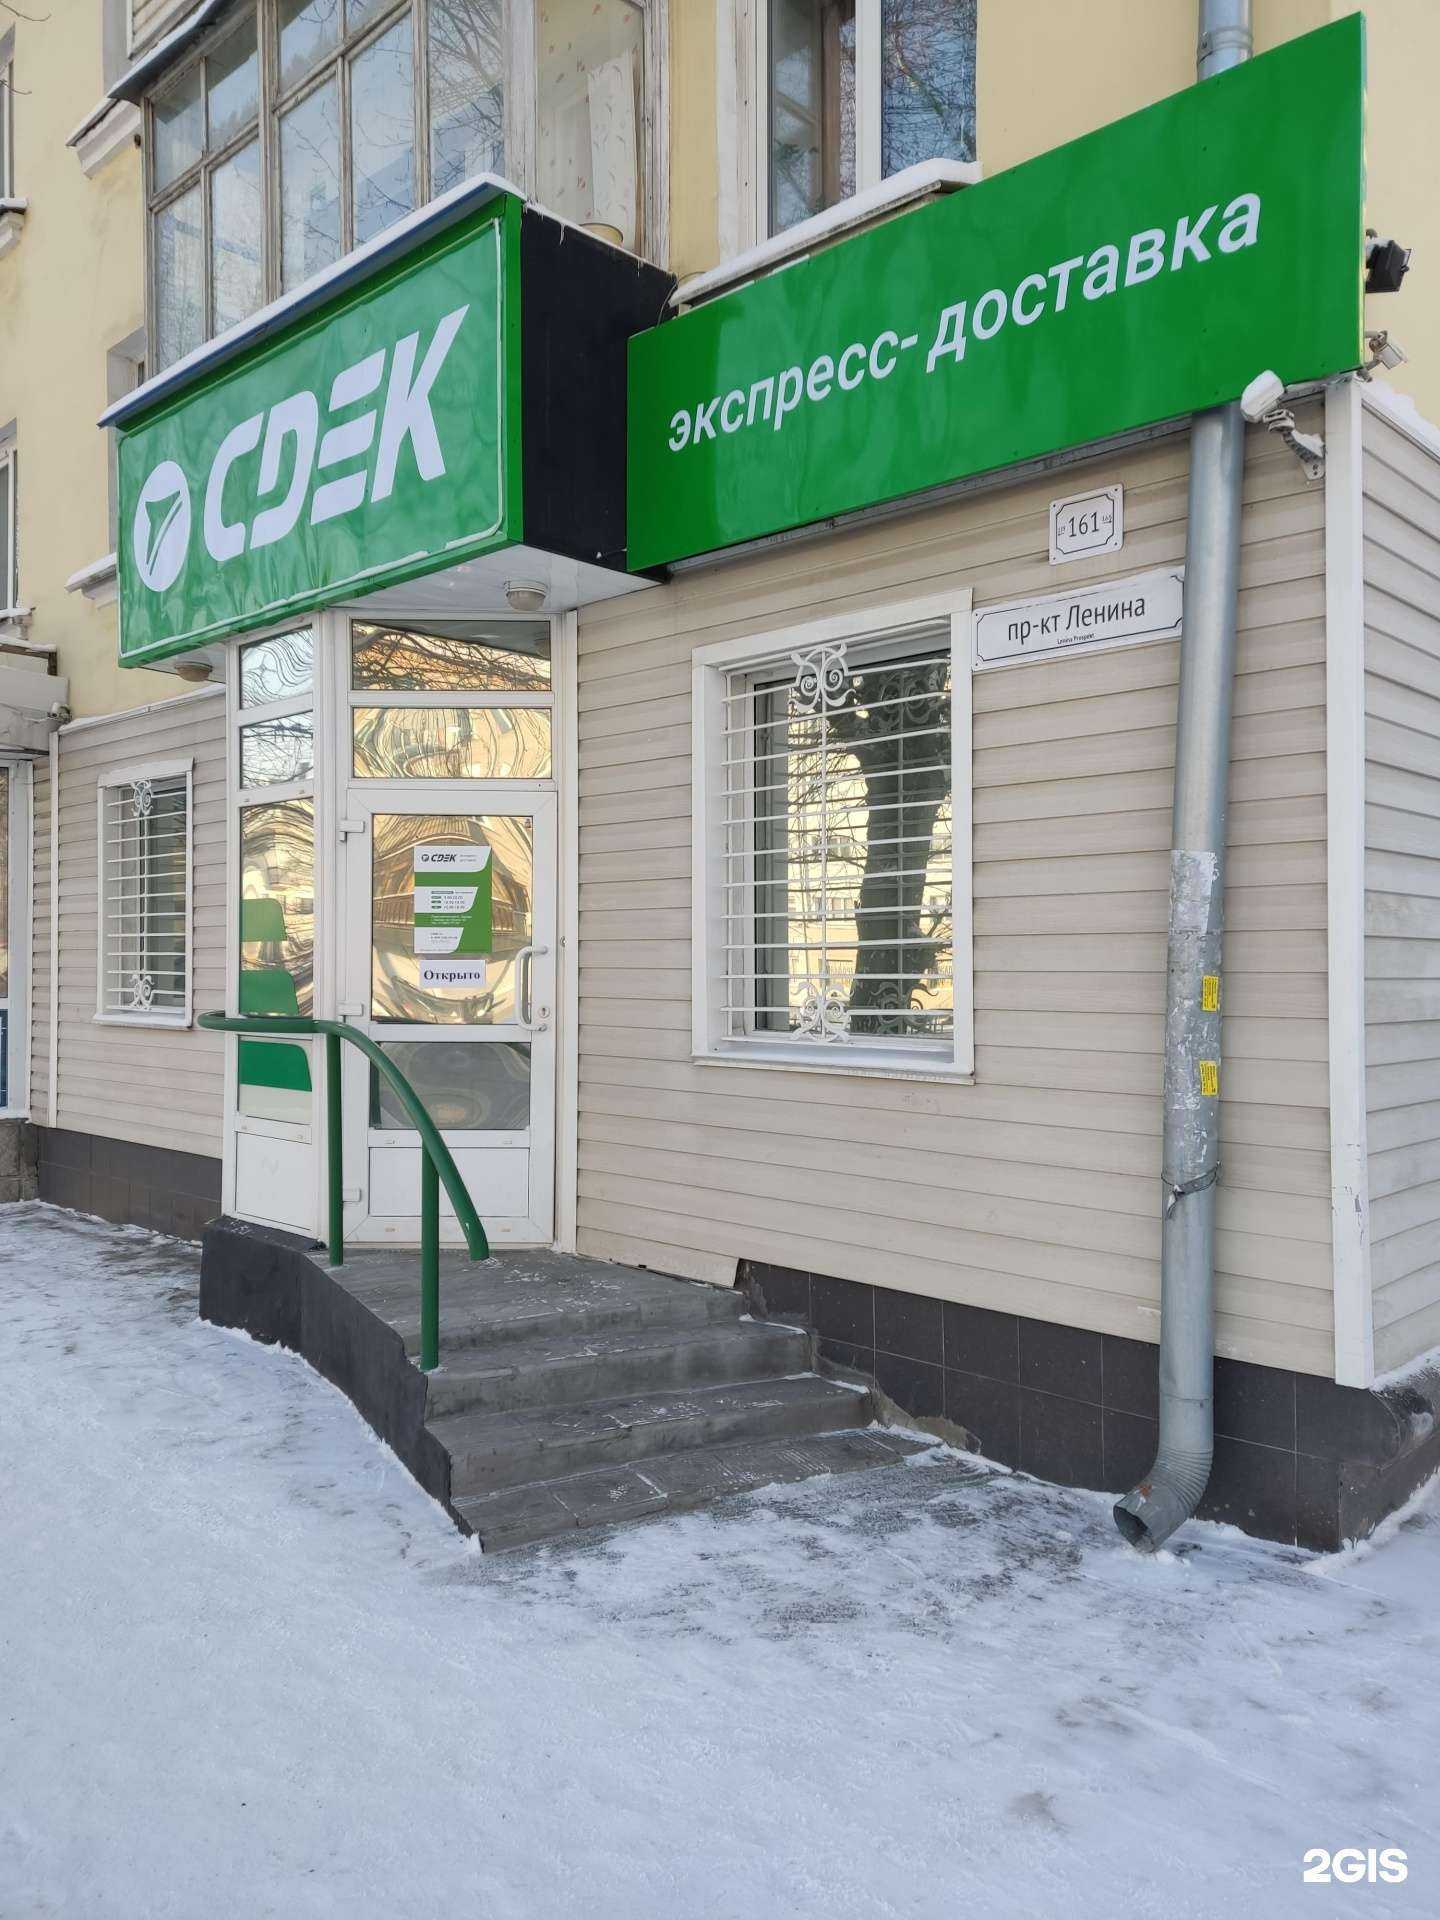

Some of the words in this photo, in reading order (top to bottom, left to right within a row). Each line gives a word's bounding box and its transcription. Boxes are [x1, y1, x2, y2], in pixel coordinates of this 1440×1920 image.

[1068, 511, 1100, 538] 161
[1008, 614, 1061, 645] пр-кт
[1066, 598, 1146, 631] Ленина
[423, 969, 481, 982] Открыто
